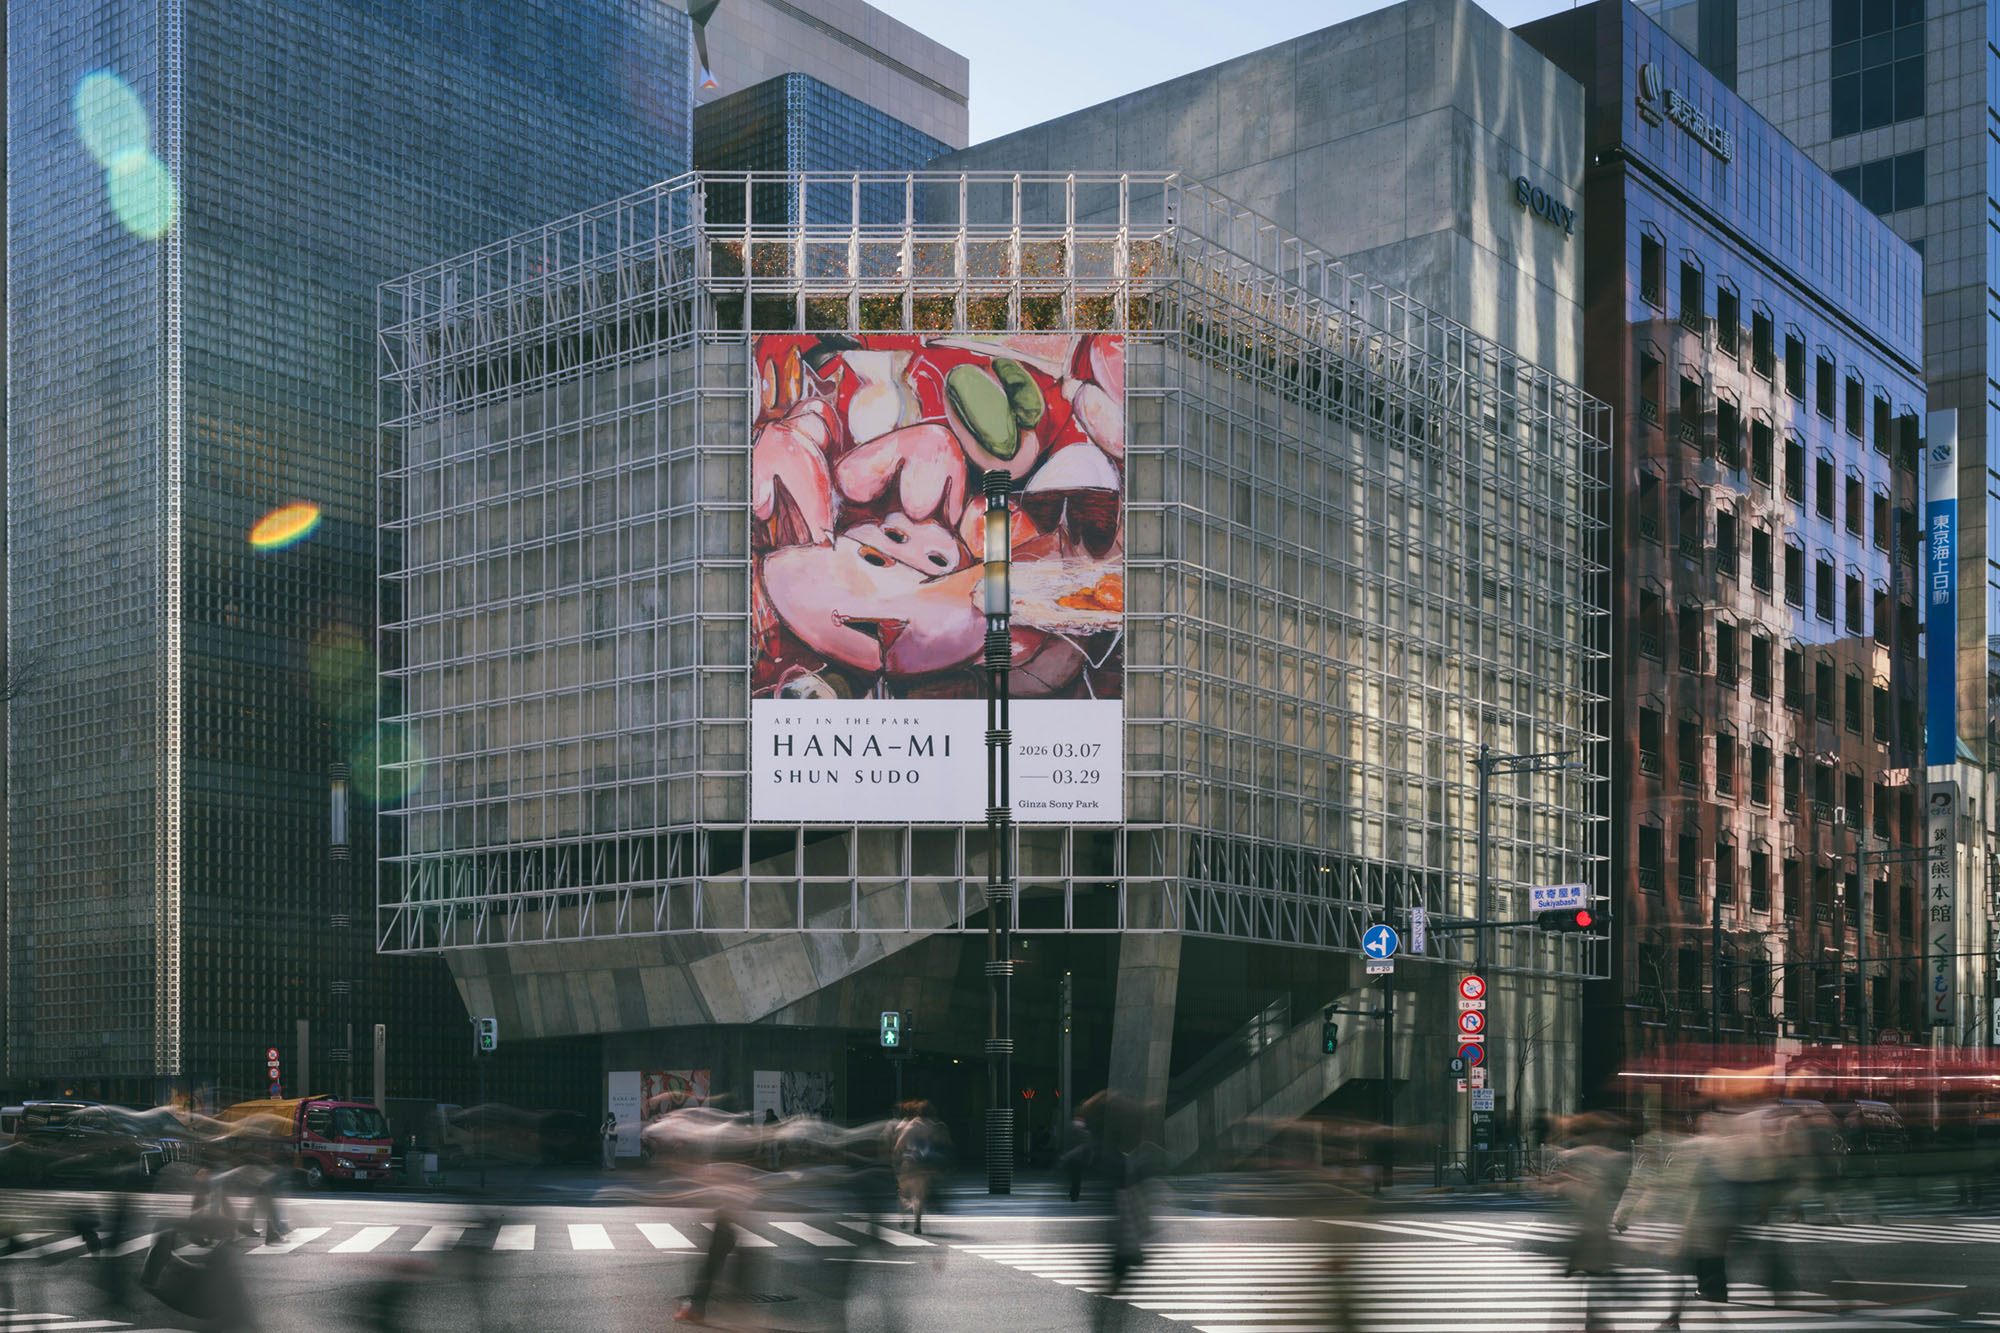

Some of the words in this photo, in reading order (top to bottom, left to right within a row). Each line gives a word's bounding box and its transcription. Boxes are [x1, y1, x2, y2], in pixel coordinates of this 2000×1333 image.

[1669, 90, 1732, 161] 東京海上日動
[1517, 176, 1576, 235] SONY
[1932, 515, 1950, 605] 東京海上日動
[774, 717, 802, 725] ART
[816, 717, 832, 725] IN
[845, 717, 870, 725] THE
[881, 717, 921, 725] PARK
[773, 734, 951, 757] HANA-MI
[1019, 745, 1048, 756] 2026
[1052, 743, 1102, 758] 03.07
[773, 769, 838, 784] SHUN
[854, 769, 920, 784] SUDO
[1052, 769, 1101, 784] 03.29
[1018, 799, 1047, 809] Ginza
[1048, 799, 1073, 811] Sony
[1075, 799, 1099, 809] Park
[1930, 828, 1952, 922] 銀座熊本館
[1534, 887, 1581, 900] 数寄屋橋
[1538, 898, 1578, 908] Sukiyabashi
[1932, 932, 1949, 1013] くまもと
